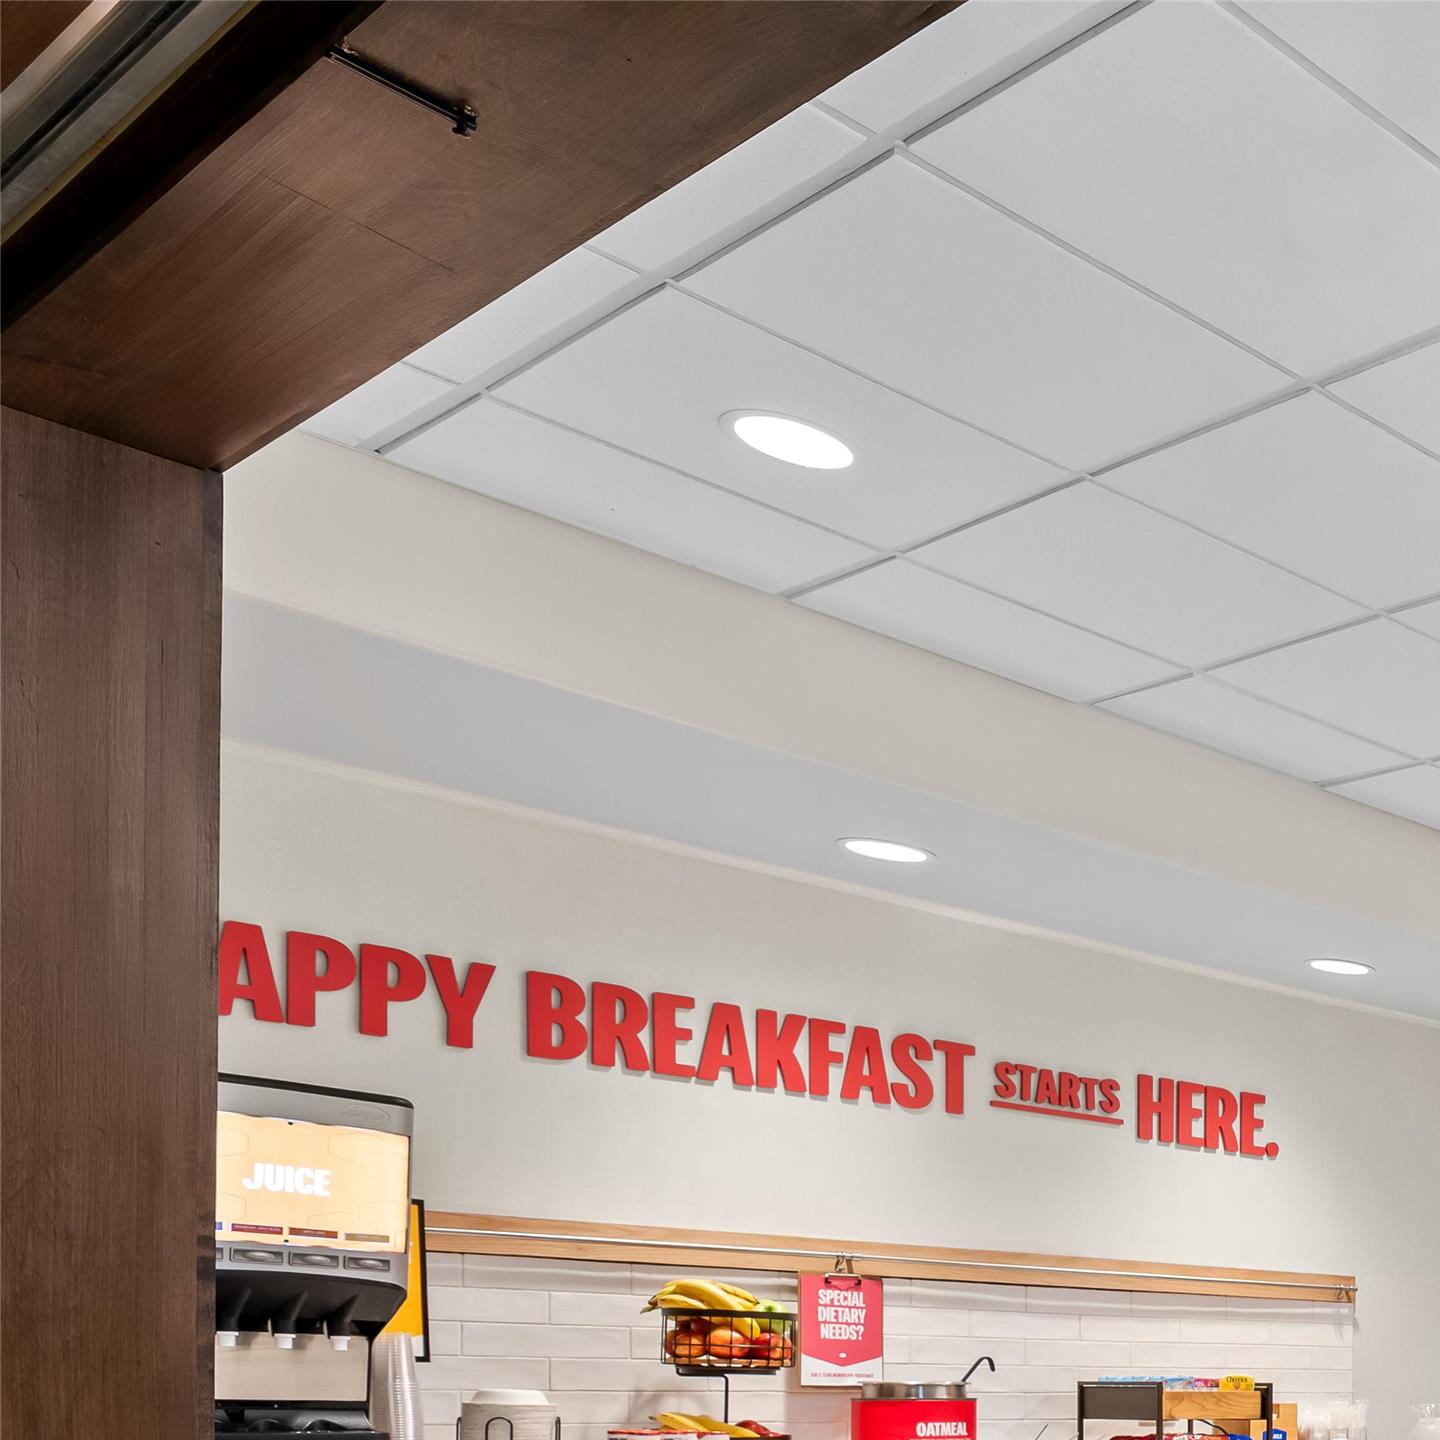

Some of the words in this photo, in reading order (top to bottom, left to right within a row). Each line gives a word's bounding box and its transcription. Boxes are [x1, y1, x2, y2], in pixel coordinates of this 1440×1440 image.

[218, 919, 496, 1048] APPY
[526, 970, 976, 1115] BREAKFAST
[993, 1061, 1121, 1114] STARTS
[1137, 1073, 1280, 1158] HERE.
[242, 1162, 332, 1197] JUICE
[818, 1288, 866, 1307] SPECIAL
[817, 1306, 866, 1323] DIETARY
[820, 1323, 865, 1340] NEEDS?
[916, 1422, 969, 1437] OATMEAL
